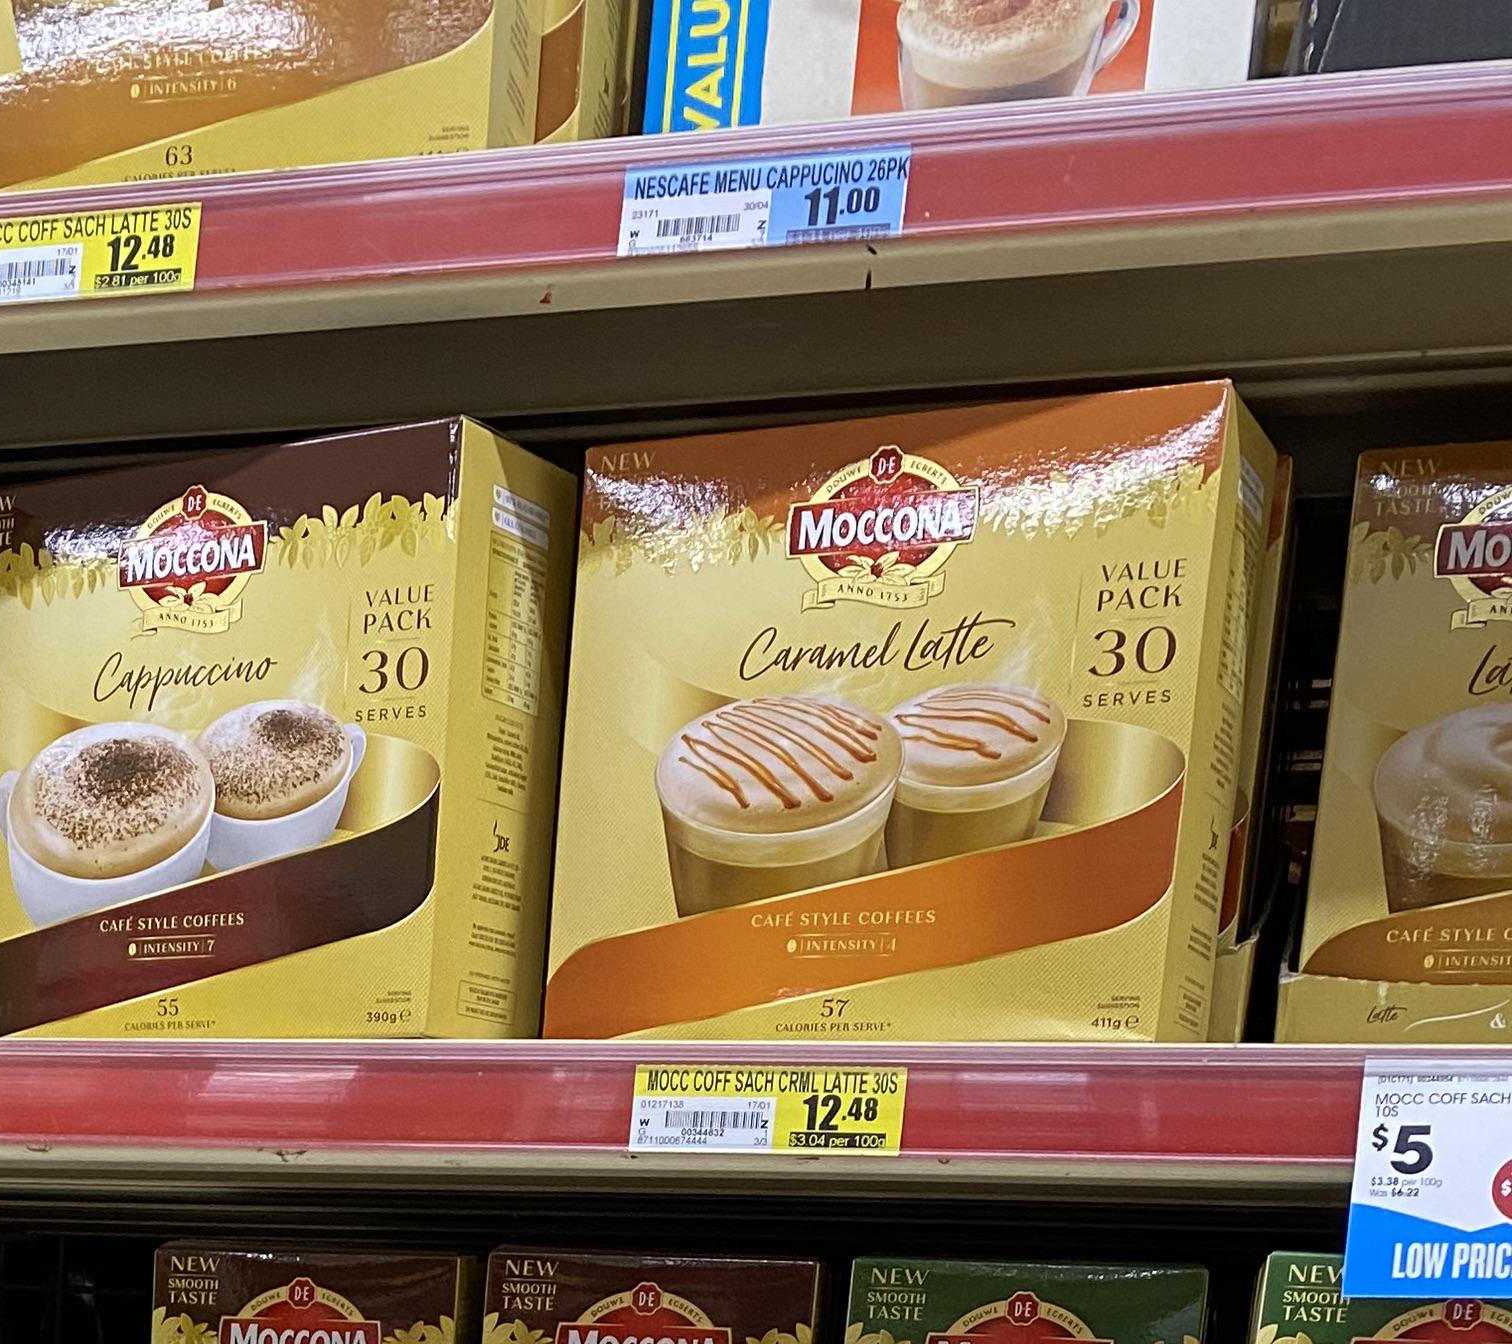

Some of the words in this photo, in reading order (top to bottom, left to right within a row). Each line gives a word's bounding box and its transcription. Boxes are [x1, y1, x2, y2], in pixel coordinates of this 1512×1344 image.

[634, 173, 710, 201] NESCAFE
[714, 169, 762, 194] MENU
[766, 161, 865, 191] CAPPUCINO
[867, 155, 910, 183] 26PK
[805, 186, 880, 227] 11.00
[18, 219, 59, 242] COFF
[64, 214, 106, 238] SACH
[111, 211, 158, 234] LATTE
[165, 207, 192, 230] 30S
[107, 234, 175, 272] 12.48
[365, 584, 434, 608] VALUE
[363, 609, 432, 634] PACK
[739, 621, 900, 681] Caramel
[904, 610, 1016, 670] Latte
[359, 647, 430, 694] 30
[355, 705, 427, 722] SERVES
[366, 1010, 397, 1024] 390g
[820, 998, 849, 1019] 57
[647, 1070, 690, 1093] MOCC
[693, 1070, 732, 1093] COFF
[734, 1070, 775, 1093] SACH
[778, 1070, 820, 1094] CRML
[823, 1071, 869, 1095] LATTE
[872, 1072, 898, 1095] 30S
[803, 1096, 878, 1131] 12.48
[170, 1256, 221, 1273] NEW
[168, 1278, 219, 1291] SMOOTH
[169, 1291, 218, 1306] TASTE
